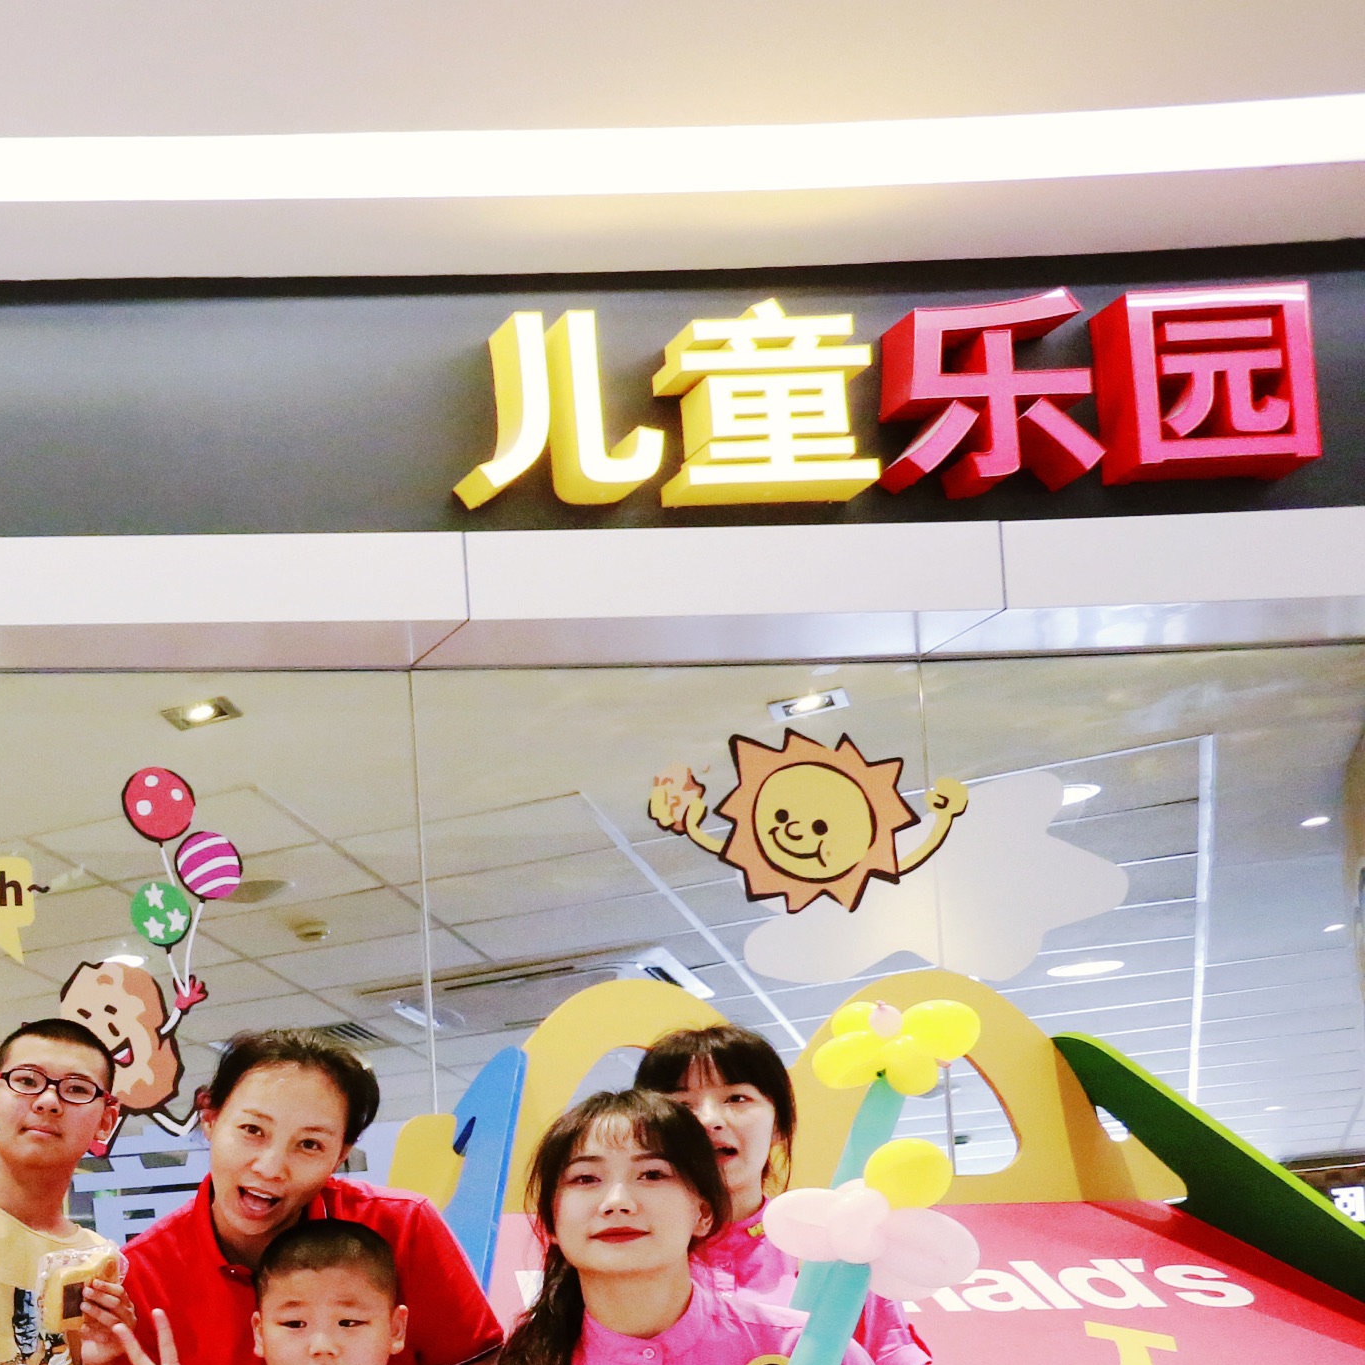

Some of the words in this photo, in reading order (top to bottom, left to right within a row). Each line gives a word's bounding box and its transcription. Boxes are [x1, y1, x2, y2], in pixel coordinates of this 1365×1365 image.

[453, 281, 1323, 510] 儿童乐园
[901, 1258, 1256, 1312] nald's
